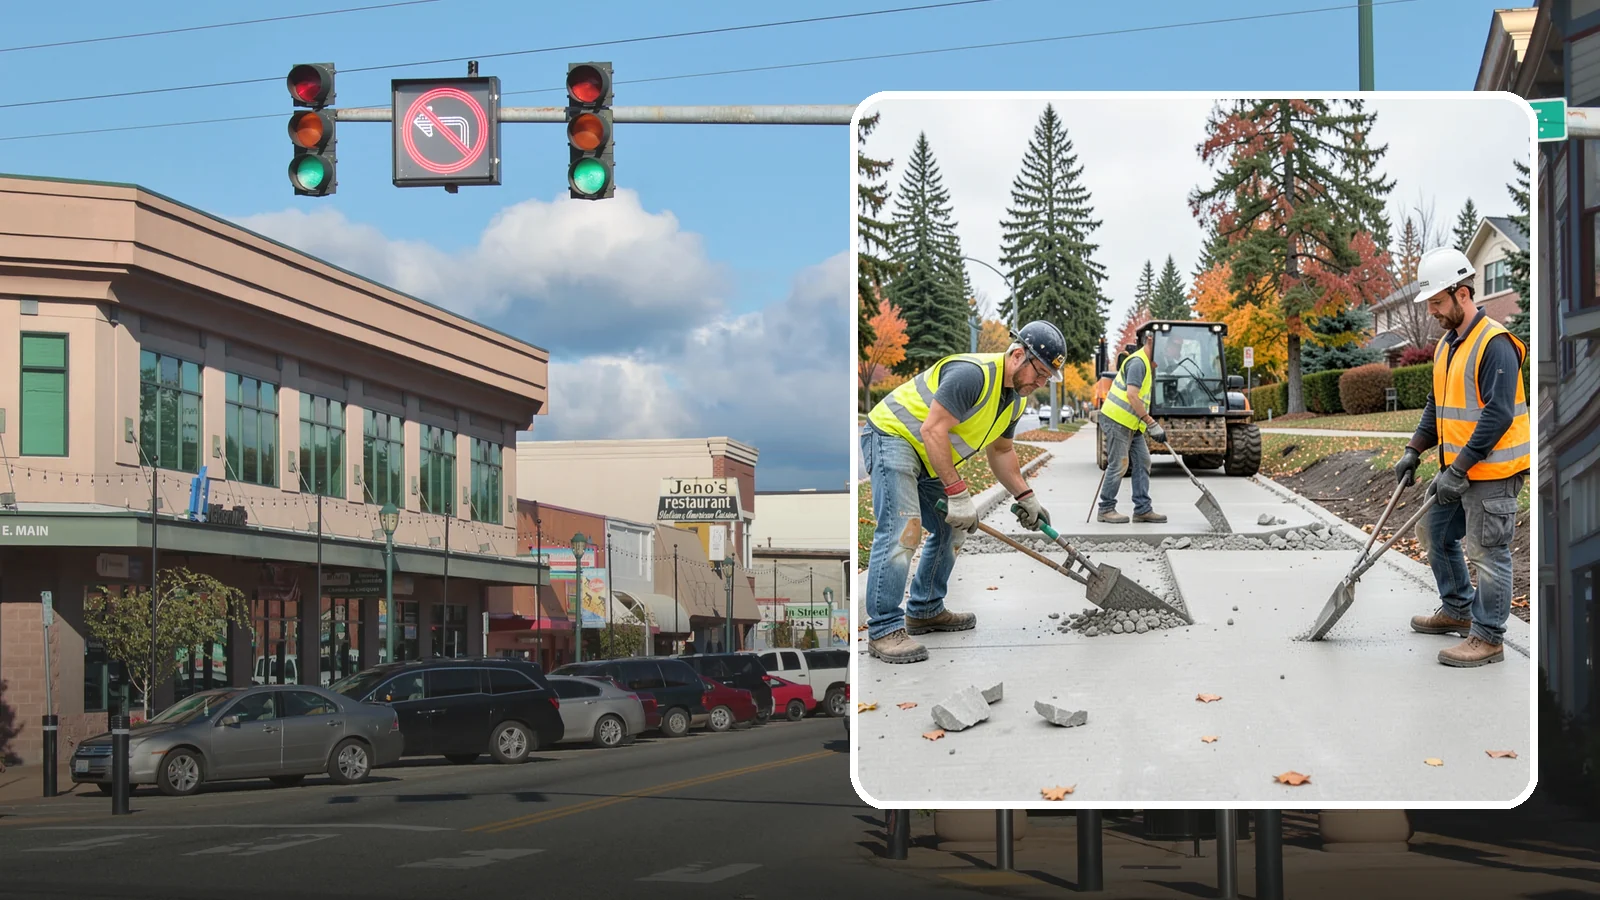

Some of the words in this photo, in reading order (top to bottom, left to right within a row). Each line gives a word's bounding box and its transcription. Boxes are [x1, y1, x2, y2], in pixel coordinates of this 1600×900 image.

[669, 480, 727, 494] Jeno's
[665, 497, 731, 509] restaurant
[659, 510, 681, 519] Italian
[686, 510, 714, 519] American
[715, 510, 737, 519] Cuisine
[2, 525, 13, 536] E.
[15, 525, 48, 536] MAIN
[797, 608, 828, 616] Street
